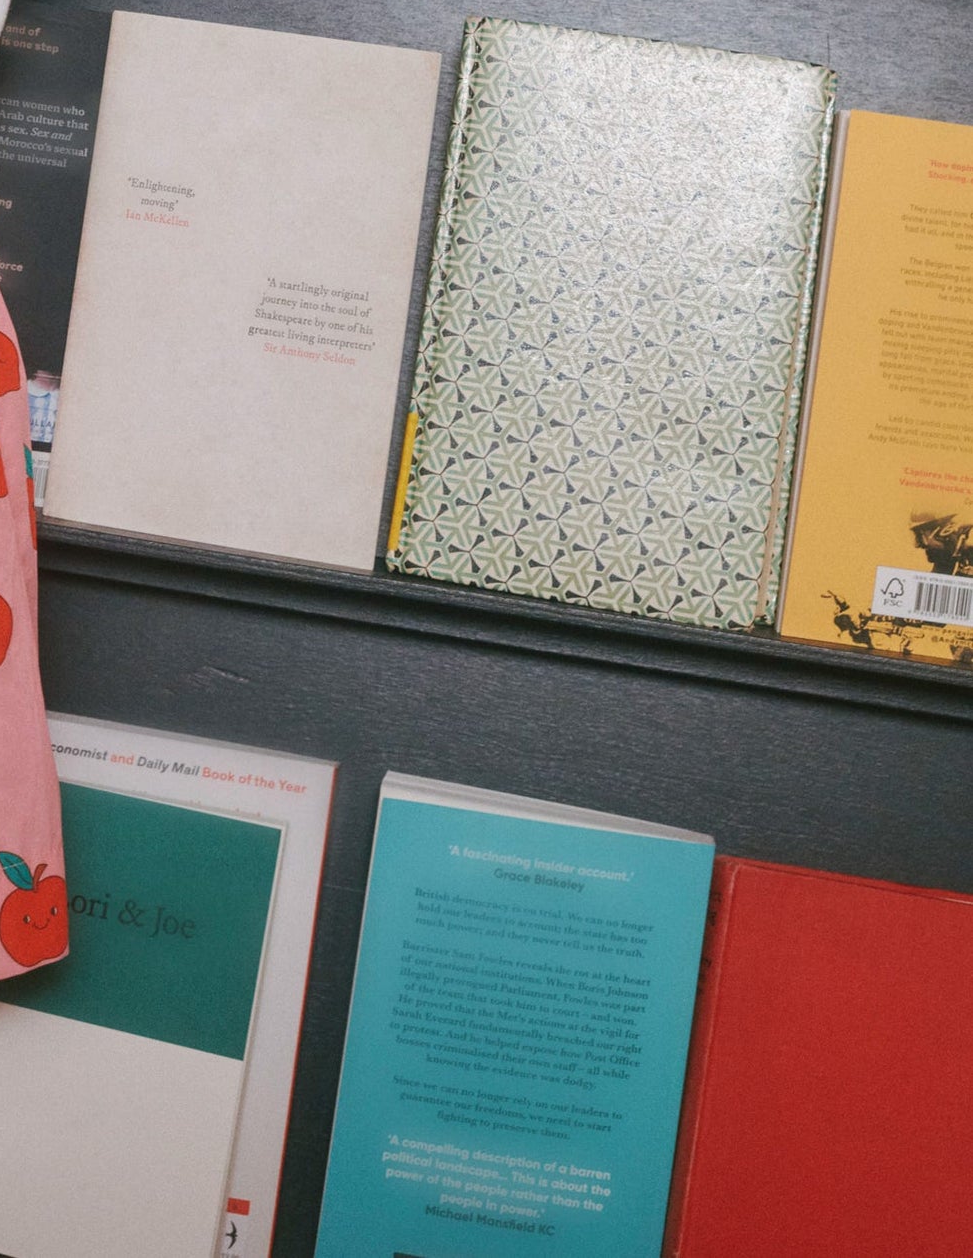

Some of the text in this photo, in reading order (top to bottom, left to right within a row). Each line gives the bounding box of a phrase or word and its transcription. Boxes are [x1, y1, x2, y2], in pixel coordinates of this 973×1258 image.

[5, 25, 41, 36] and of
[13, 40, 32, 49] one
[35, 44, 59, 55] step
[22, 101, 60, 113] women
[63, 105, 85, 117] who
[8, 124, 73, 141] sex. Sex and
[27, 114, 65, 127] culture
[67, 120, 89, 130] that
[17, 154, 67, 168] universal
[54, 145, 88, 157] sexual
[125, 209, 189, 227] Ian McKellen
[279, 281, 329, 297] startlingly
[331, 288, 369, 301] original
[260, 293, 373, 318] journey into the soul of
[254, 308, 373, 335] Shakespeare by one of his
[247, 325, 285, 338] greatest
[287, 329, 315, 346] living
[263, 342, 356, 366] Sir Anthony Seldon
[50, 744, 308, 794] conomist and Daily Mail Book of the Year
[463, 847, 531, 869] fascinating
[533, 858, 576, 874] insider
[494, 868, 586, 893] Grace Blakeley
[67, 893, 195, 939] ori & Joe
[415, 887, 655, 934] British democracy longer
[402, 1137, 470, 1160] compelling
[472, 1148, 541, 1170] description
[543, 1160, 557, 1172] of
[558, 1165, 567, 1174] a
[570, 1165, 611, 1181] barren
[382, 1150, 433, 1166] political
[511, 1170, 536, 1185] This
[538, 1177, 548, 1188] is
[551, 1179, 588, 1195] about
[590, 1184, 611, 1197] the
[385, 1166, 604, 1212] power of the people rather than the
[439, 1192, 483, 1210] people
[485, 1199, 497, 1211] in
[426, 1204, 556, 1236] Michael Mansfield KC
